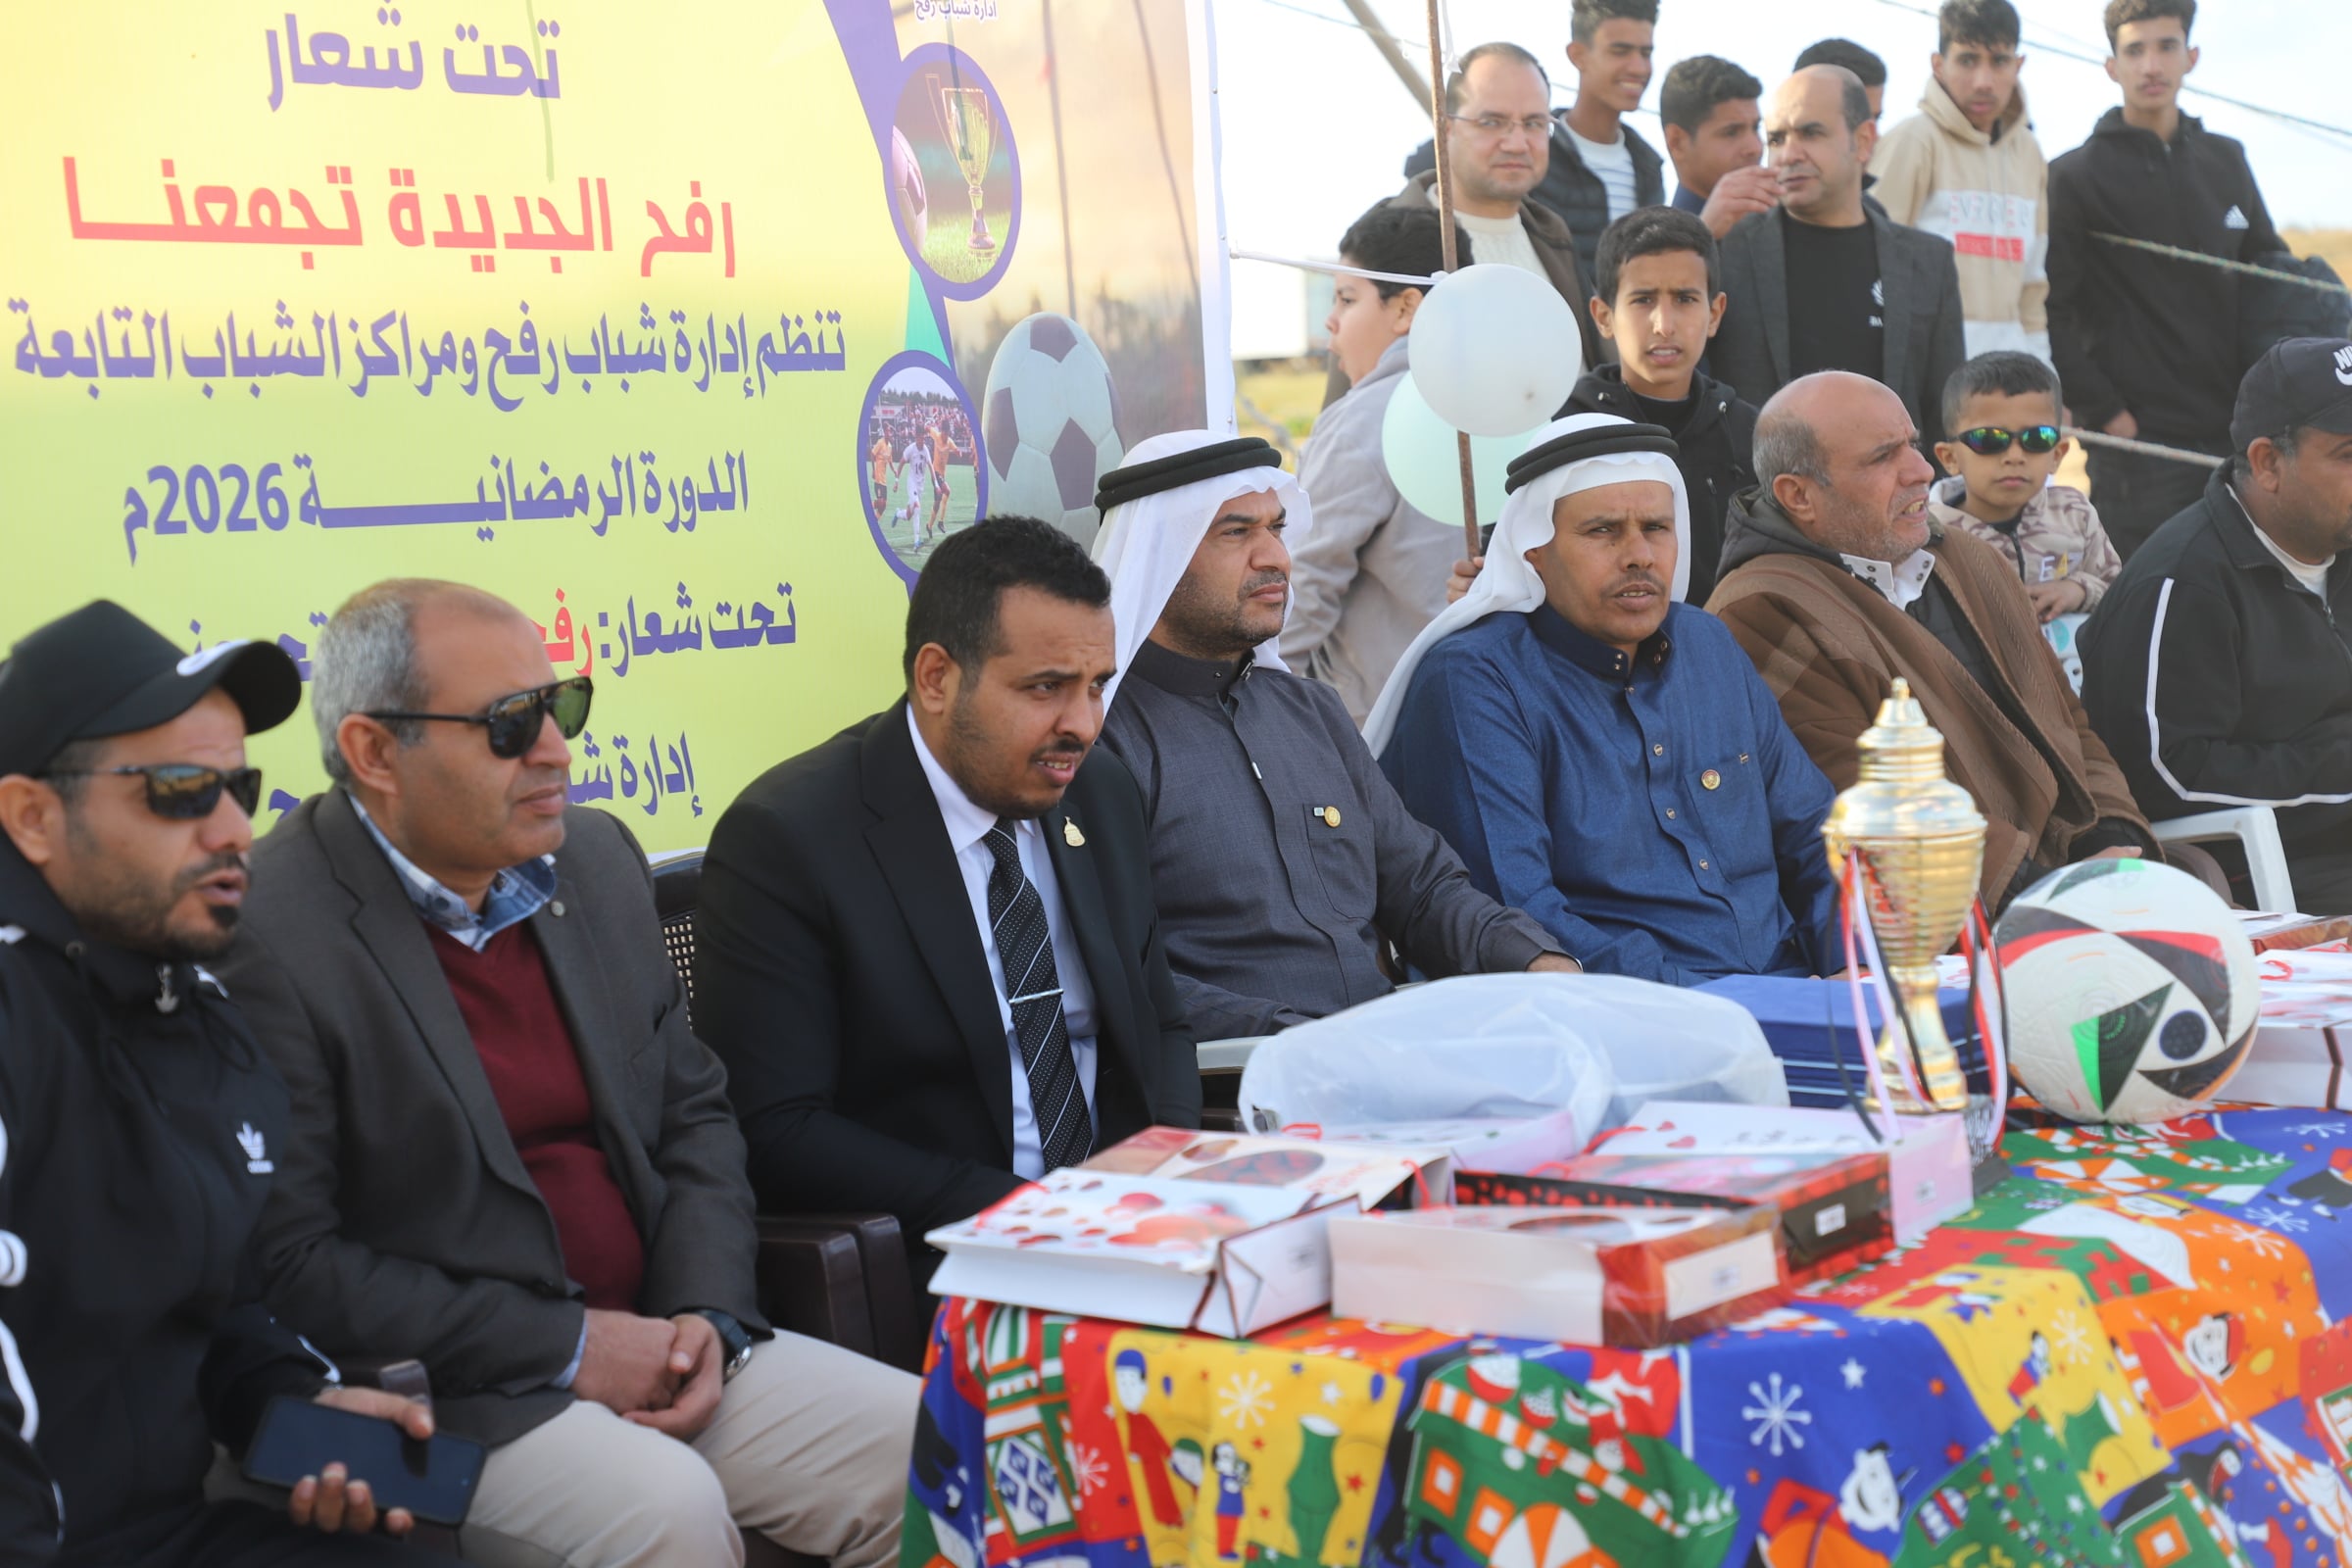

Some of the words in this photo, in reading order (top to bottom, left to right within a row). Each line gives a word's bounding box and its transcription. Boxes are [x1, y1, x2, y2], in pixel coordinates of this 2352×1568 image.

[265, 0, 424, 113] شعار
[442, 18, 562, 100] تحت
[61, 155, 365, 270] تجمعنا
[388, 168, 614, 274] الجديدة
[640, 179, 737, 279] رفح
[7, 296, 173, 401] التابعة
[180, 298, 341, 400] الشباب
[346, 308, 479, 398] ومراكز
[483, 299, 561, 413] رفح
[564, 300, 667, 395] شباب
[668, 309, 756, 401] إدارة
[756, 308, 847, 401] تنظم
[638, 448, 749, 533] الدورة
[529, 587, 593, 678] رف
[597, 580, 703, 678] شعار:
[708, 580, 797, 650] تحت
[612, 728, 704, 819] إدارة
